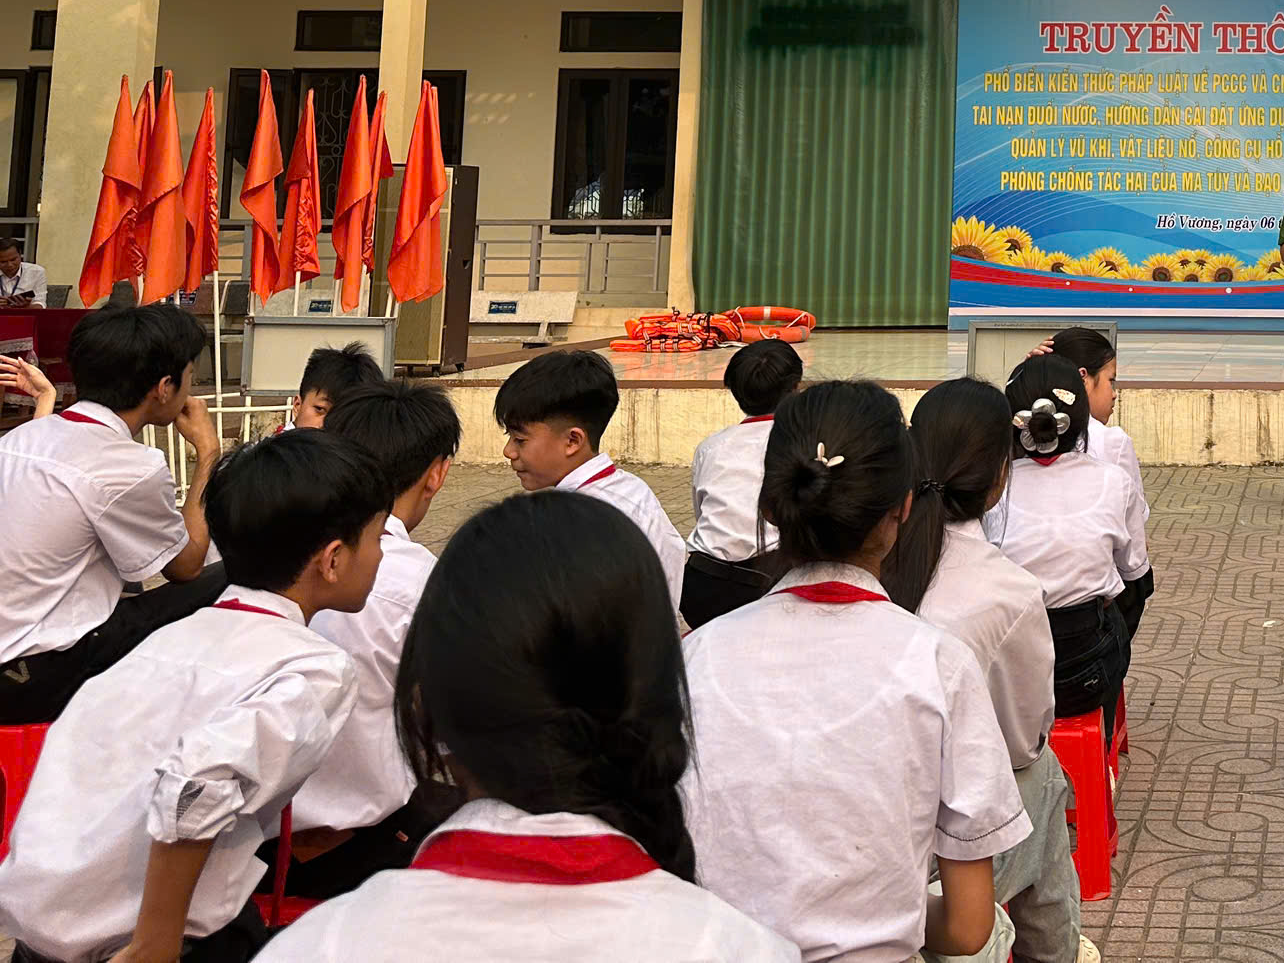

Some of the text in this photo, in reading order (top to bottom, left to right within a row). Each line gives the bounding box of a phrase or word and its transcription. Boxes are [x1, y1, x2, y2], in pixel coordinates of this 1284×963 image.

[1039, 5, 1203, 55] TRUYỀN
[984, 65, 1011, 93] PHỔ
[1014, 66, 1044, 93] BIẾN
[1048, 66, 1079, 93] KIẾN
[1083, 68, 1115, 93] THỨC
[1119, 69, 1153, 93] PHÁP
[1157, 69, 1190, 97] LUẬT
[1193, 66, 1209, 94] VỀ
[1213, 74, 1248, 93] PCCC
[1252, 69, 1268, 94] VÀ
[973, 106, 992, 125] TAI
[996, 106, 1023, 130] NẠN
[1027, 99, 1058, 125] ĐUỐI
[1105, 101, 1149, 125] HƯỚNG
[1153, 99, 1180, 125] DẪN
[1184, 103, 1206, 126] CÀI
[1210, 102, 1234, 131] ĐẶT
[1238, 102, 1265, 126] ỨNG
[1011, 130, 1046, 159] QUẢN
[1050, 134, 1065, 158] LÝ
[1069, 134, 1086, 158] VŨ
[1119, 134, 1143, 162] VẬT
[1147, 134, 1174, 162] LIỆU
[1205, 134, 1240, 159] CÔNG
[1245, 140, 1262, 163] CỤ
[1266, 132, 1283, 159] HỖ
[1000, 166, 1045, 191] PHÒNG
[1049, 165, 1093, 191] CHỐNG
[1097, 167, 1121, 191] TÁC
[1126, 172, 1147, 196] HẠI
[1151, 164, 1178, 191] CỦA
[1181, 172, 1203, 191] MA
[1207, 167, 1231, 192] TÚY
[1234, 167, 1250, 192] VÀ
[1255, 172, 1281, 197] BẠO
[1156, 213, 1176, 229] Hồ
[1180, 215, 1222, 231] Vương,
[1226, 217, 1257, 232] ngày
[1260, 216, 1276, 229] 06
